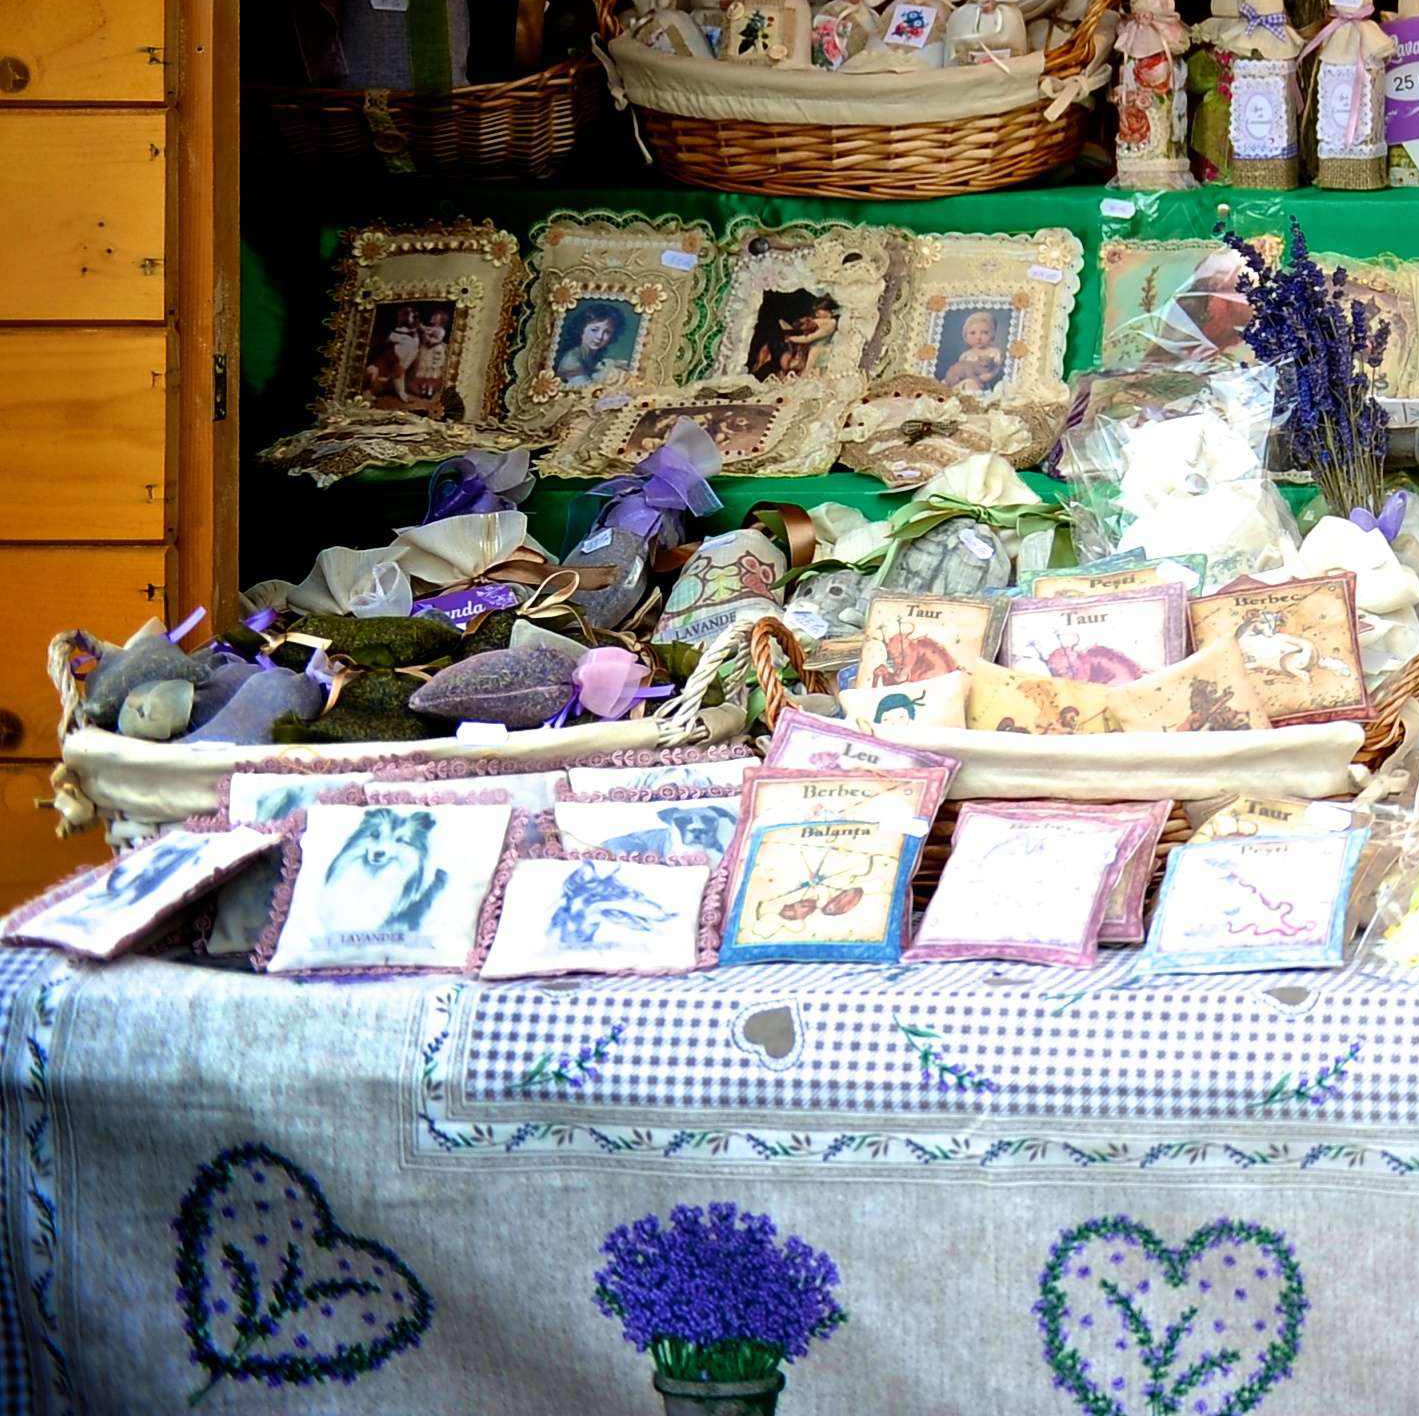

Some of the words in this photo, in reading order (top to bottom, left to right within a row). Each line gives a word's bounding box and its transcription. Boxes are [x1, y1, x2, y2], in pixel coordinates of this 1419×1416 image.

[1393, 74, 1415, 92] 25
[1235, 592, 1301, 607] Berbec
[905, 604, 943, 620] Taur
[1060, 610, 1109, 626] Taur
[842, 742, 880, 765] Leu
[802, 784, 872, 799] Berbec
[1245, 800, 1293, 821] Taur
